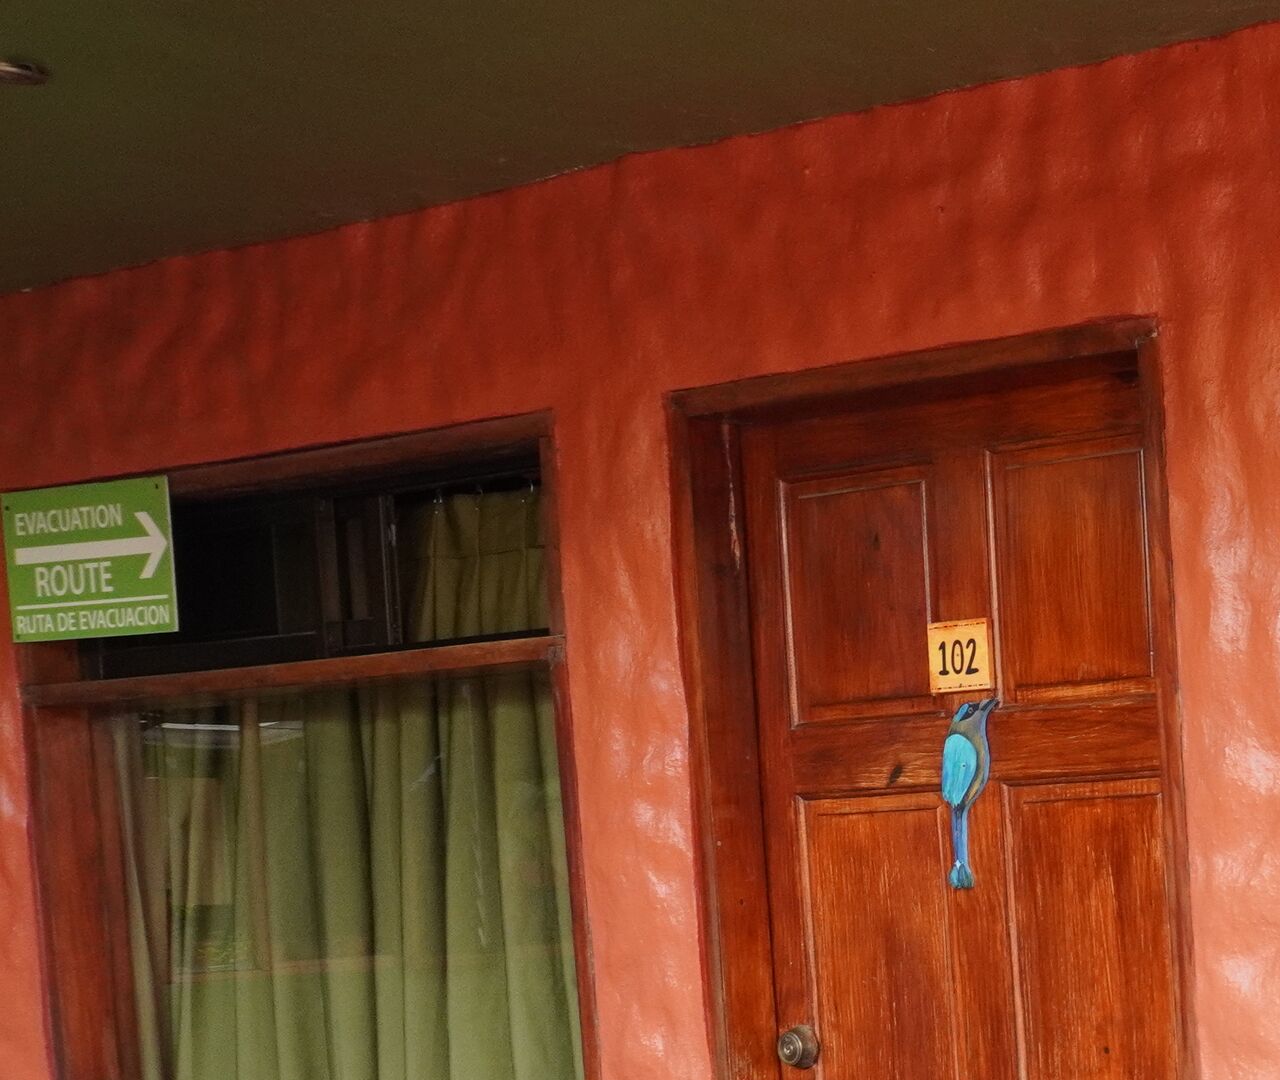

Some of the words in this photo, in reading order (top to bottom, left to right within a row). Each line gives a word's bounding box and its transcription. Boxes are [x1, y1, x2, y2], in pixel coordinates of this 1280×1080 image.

[15, 503, 123, 536] EVACUATION
[34, 560, 115, 598] ROUTE
[16, 613, 56, 634] RUTA
[57, 611, 77, 632] DE
[80, 604, 171, 631] EVACUACION
[938, 638, 980, 676] 102
